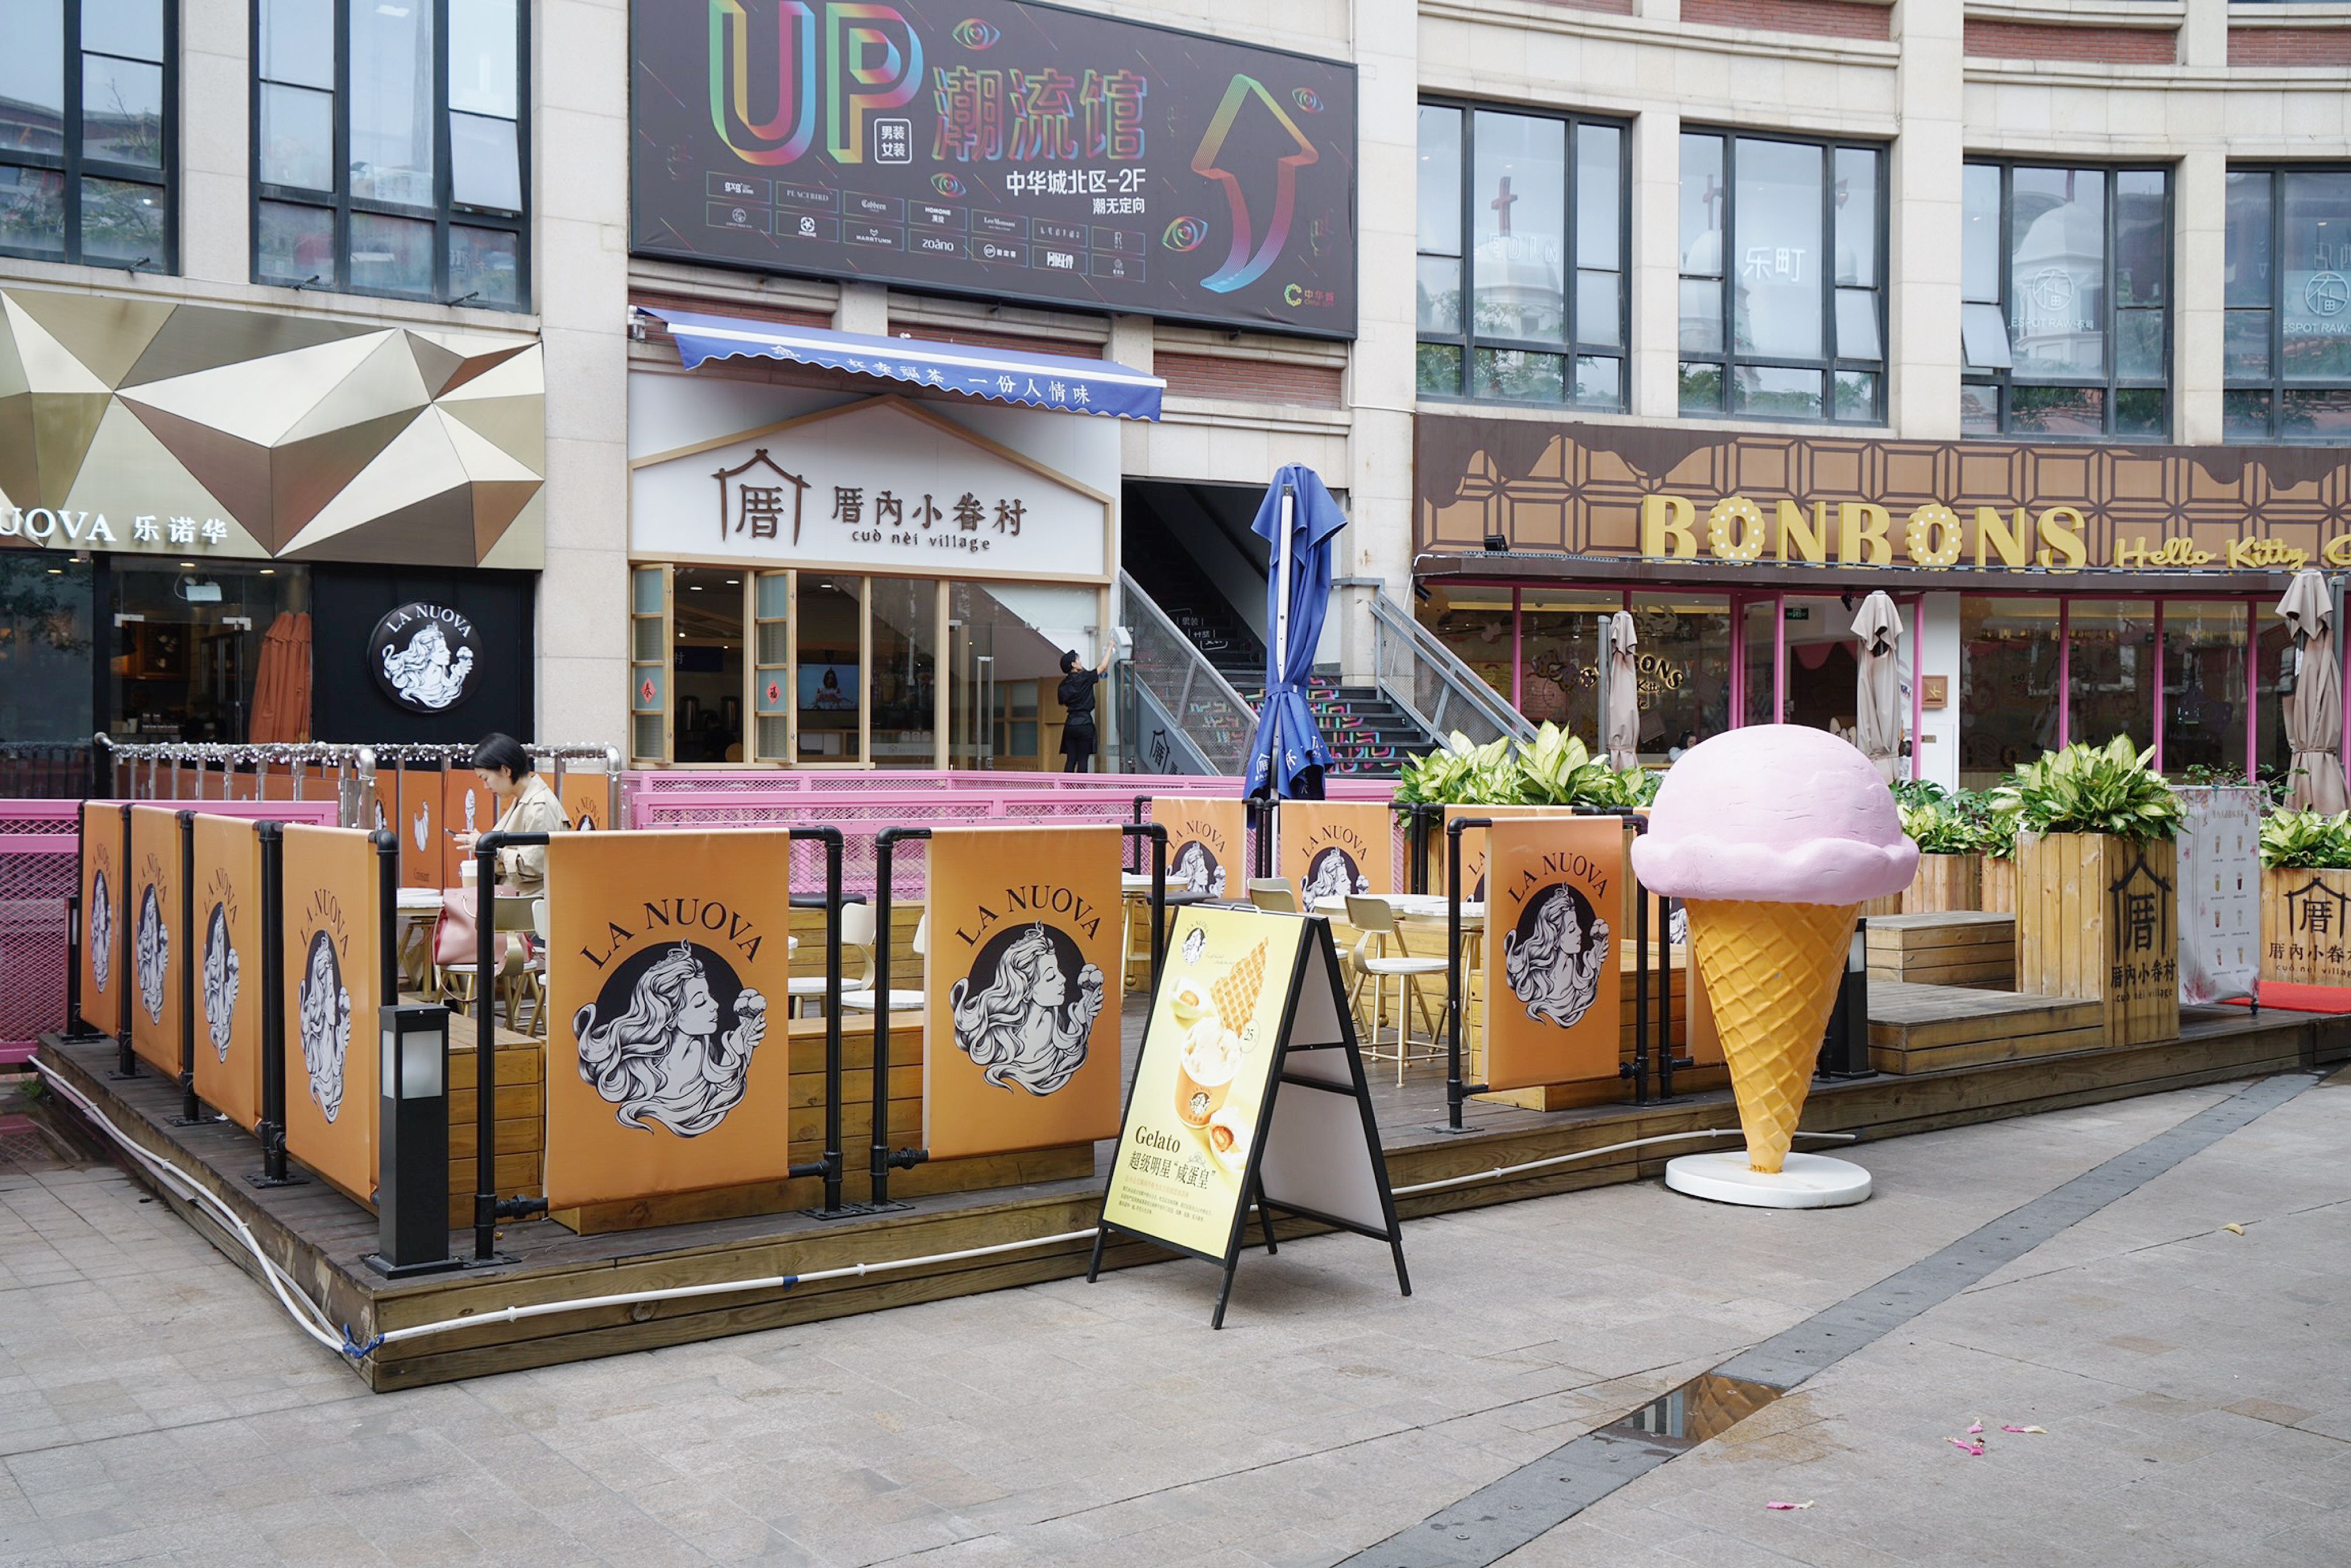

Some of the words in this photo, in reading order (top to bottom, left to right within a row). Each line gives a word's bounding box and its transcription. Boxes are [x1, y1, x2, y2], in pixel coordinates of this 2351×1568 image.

[709, 0, 924, 166] UP
[932, 65, 1148, 162] 潮流馆
[881, 125, 905, 140] 男装
[881, 142, 906, 158] 女装
[1006, 168, 1146, 196] 中华城北区-2F
[1093, 197, 1145, 215] 潮无定向
[1743, 247, 1806, 283] 乐町
[967, 375, 1091, 405] 一份人情味
[134, 515, 228, 544] 乐诺华
[929, 535, 991, 554] village
[1642, 494, 2087, 574] BONBONS
[2114, 536, 2217, 568] Hello
[2225, 536, 2310, 574] Kitty
[386, 612, 413, 634] LA
[415, 604, 471, 638] NUOVA
[1167, 829, 1183, 850] LA
[1185, 820, 1226, 853] NUOVA
[1301, 835, 1320, 859] LA
[1321, 824, 1368, 862] NUOVA
[1508, 869, 1538, 904] LA
[1542, 852, 1608, 899] NUOVA
[314, 888, 349, 959] NUOVA
[955, 905, 999, 947] LA
[1005, 885, 1101, 940] NUOVA
[580, 921, 635, 970] LA
[644, 898, 763, 963] NUOVA
[1135, 1125, 1181, 1153] Gelato
